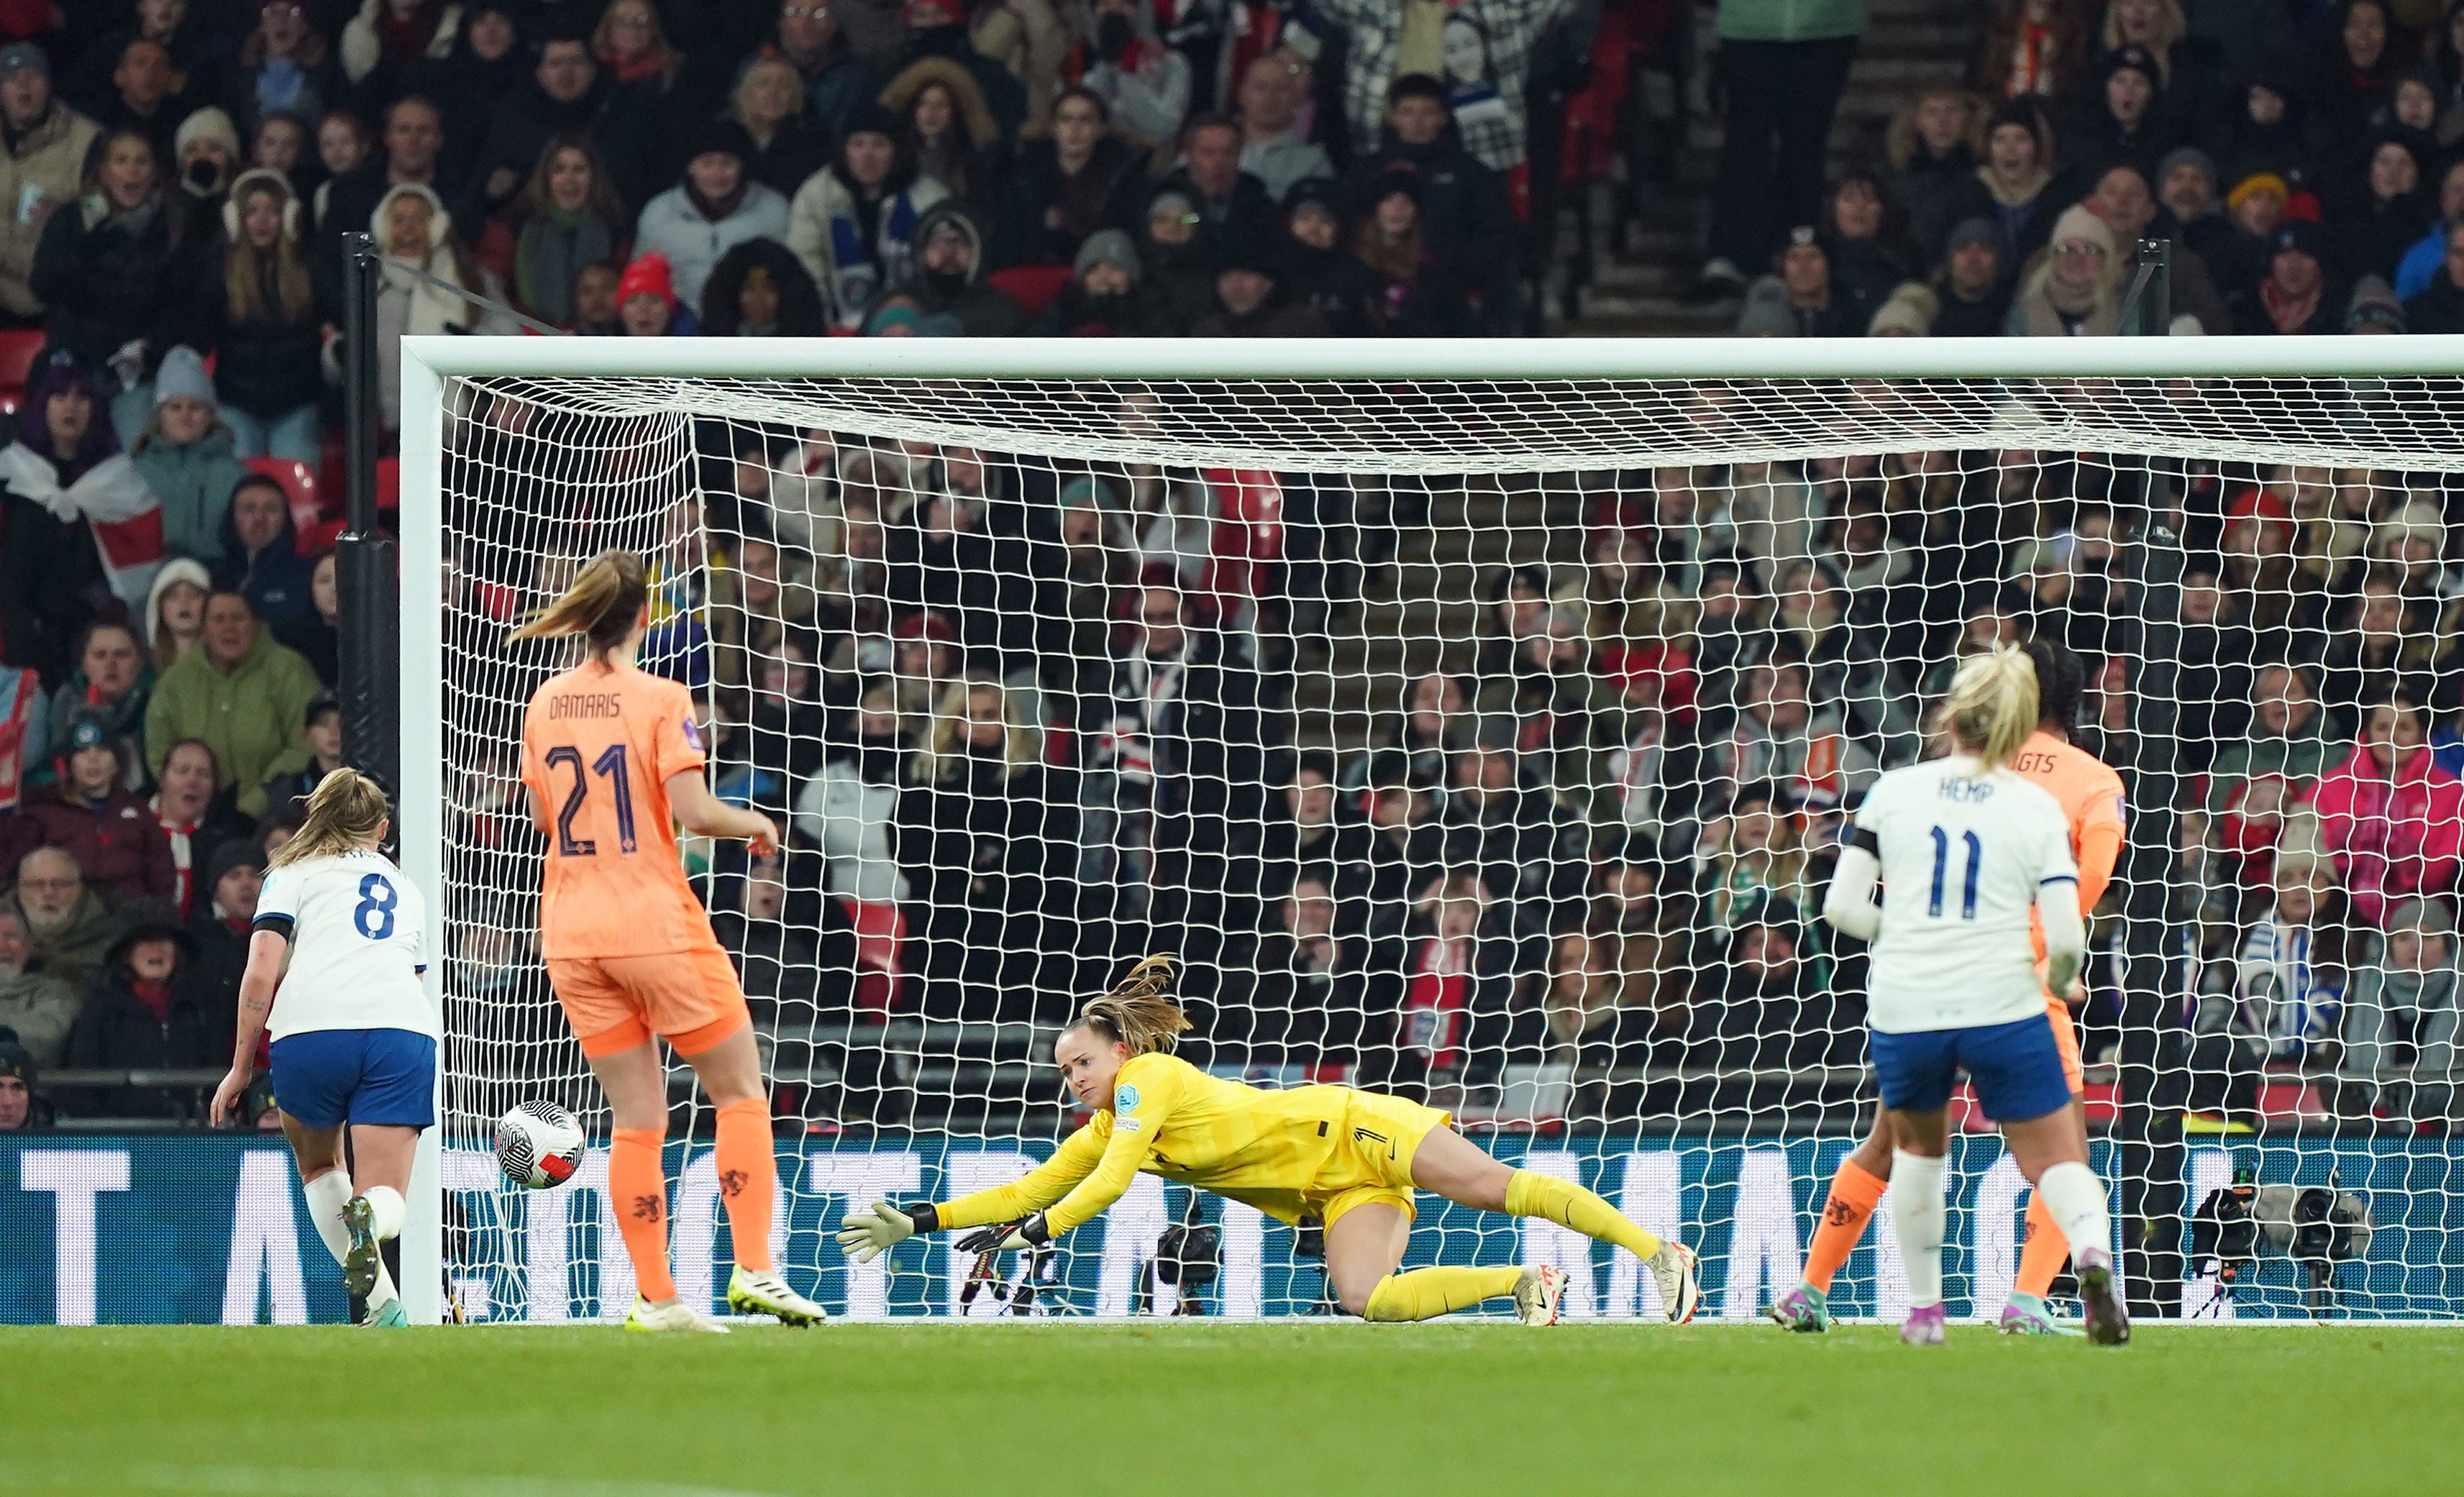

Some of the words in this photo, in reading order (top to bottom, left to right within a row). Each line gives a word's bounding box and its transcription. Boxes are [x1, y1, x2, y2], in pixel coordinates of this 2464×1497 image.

[549, 693, 621, 720] DAMARIS
[544, 744, 636, 856] 21
[1939, 777, 1994, 803] HEMP
[1928, 825, 1981, 920] 11
[354, 873, 398, 940] 8
[1354, 1127, 1388, 1144] 1
